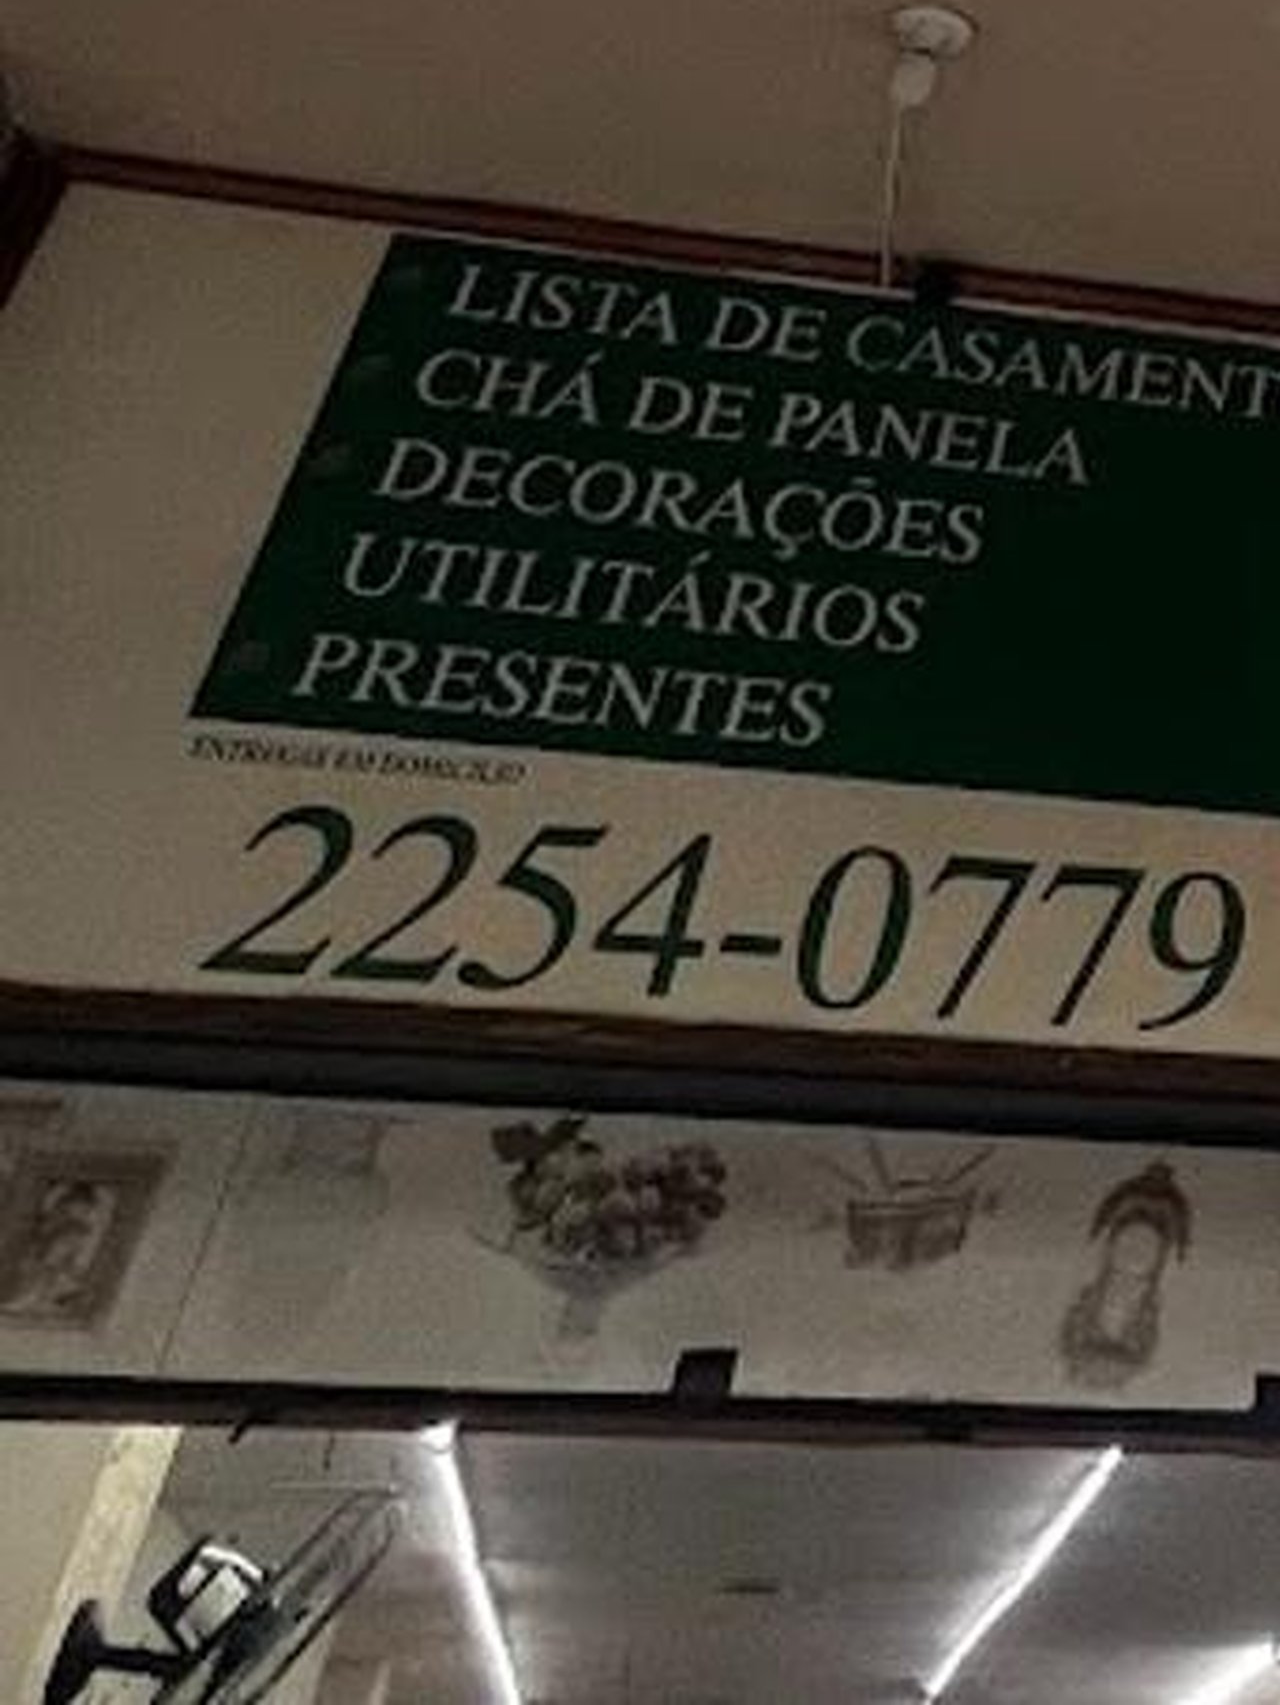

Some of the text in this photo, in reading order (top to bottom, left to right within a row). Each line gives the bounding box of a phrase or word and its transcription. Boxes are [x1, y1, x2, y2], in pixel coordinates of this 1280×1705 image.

[448, 263, 677, 348] LISTA
[705, 297, 828, 361] DE
[414, 347, 1090, 485] CHÁ DE PANELA
[374, 438, 984, 563] DECORAÇÕES
[344, 533, 926, 654] UTILITÁRIOS
[293, 632, 833, 748] PRESENTES
[199, 804, 1247, 1030] 2254-0779
